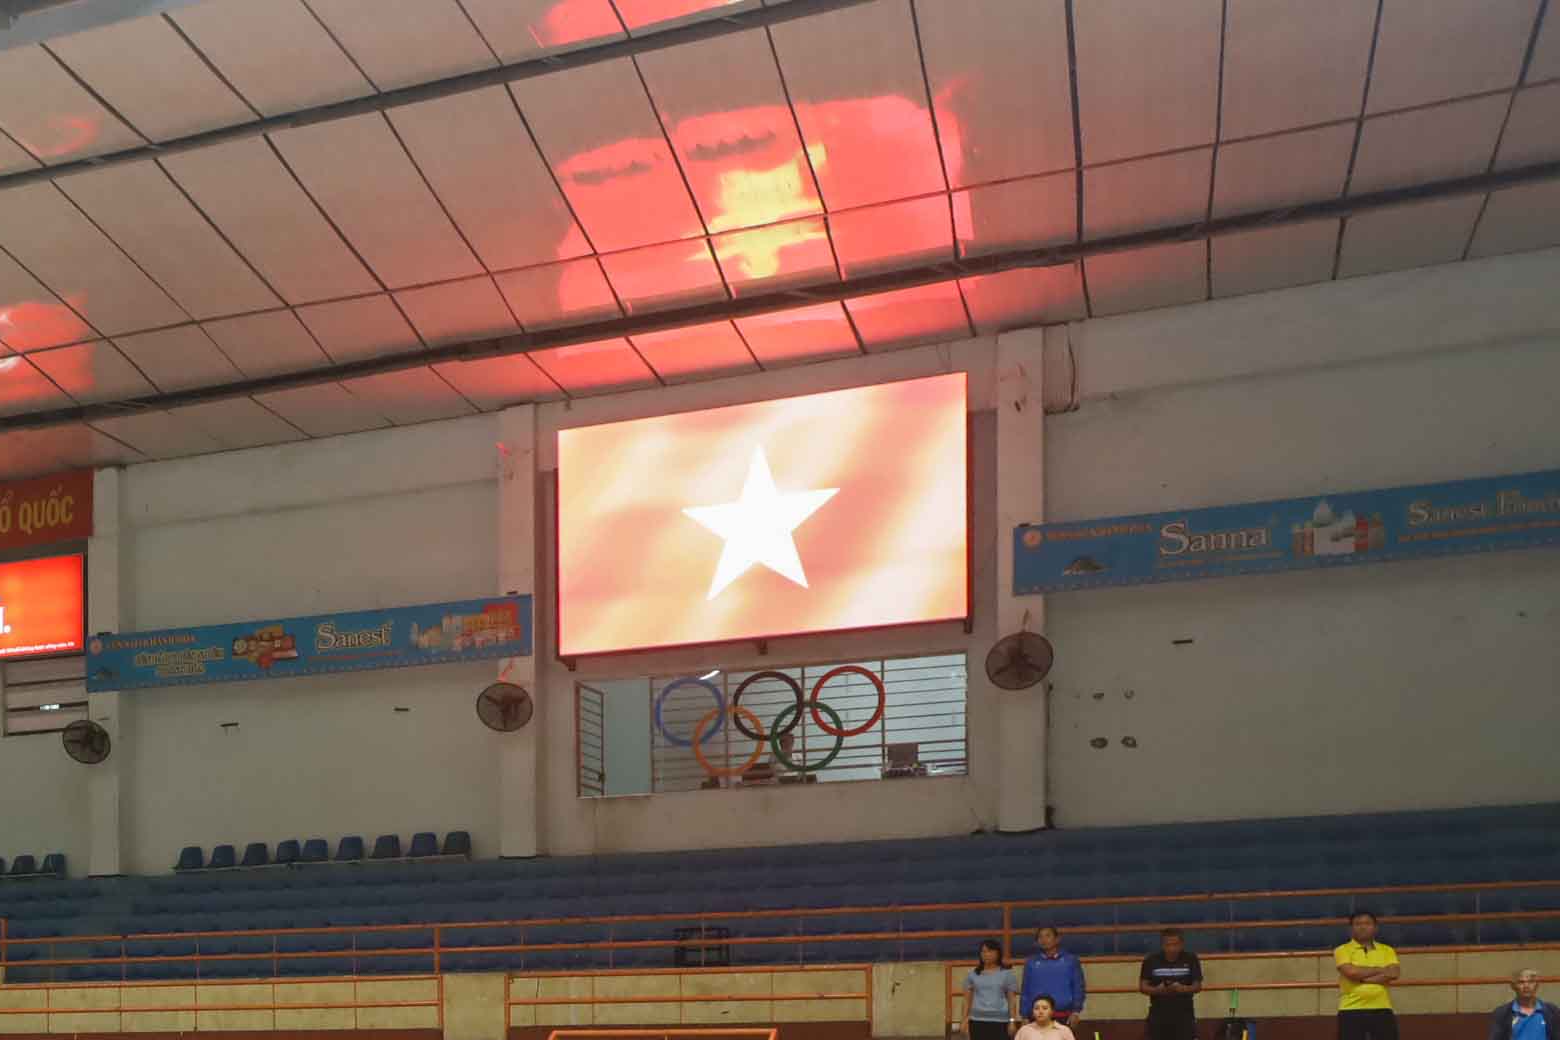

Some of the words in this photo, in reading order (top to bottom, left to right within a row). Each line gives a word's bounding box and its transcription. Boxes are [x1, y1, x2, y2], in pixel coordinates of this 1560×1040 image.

[19, 484, 75, 530] QUỐC
[1159, 521, 1267, 556] Sanna
[316, 621, 390, 650] Sanest
